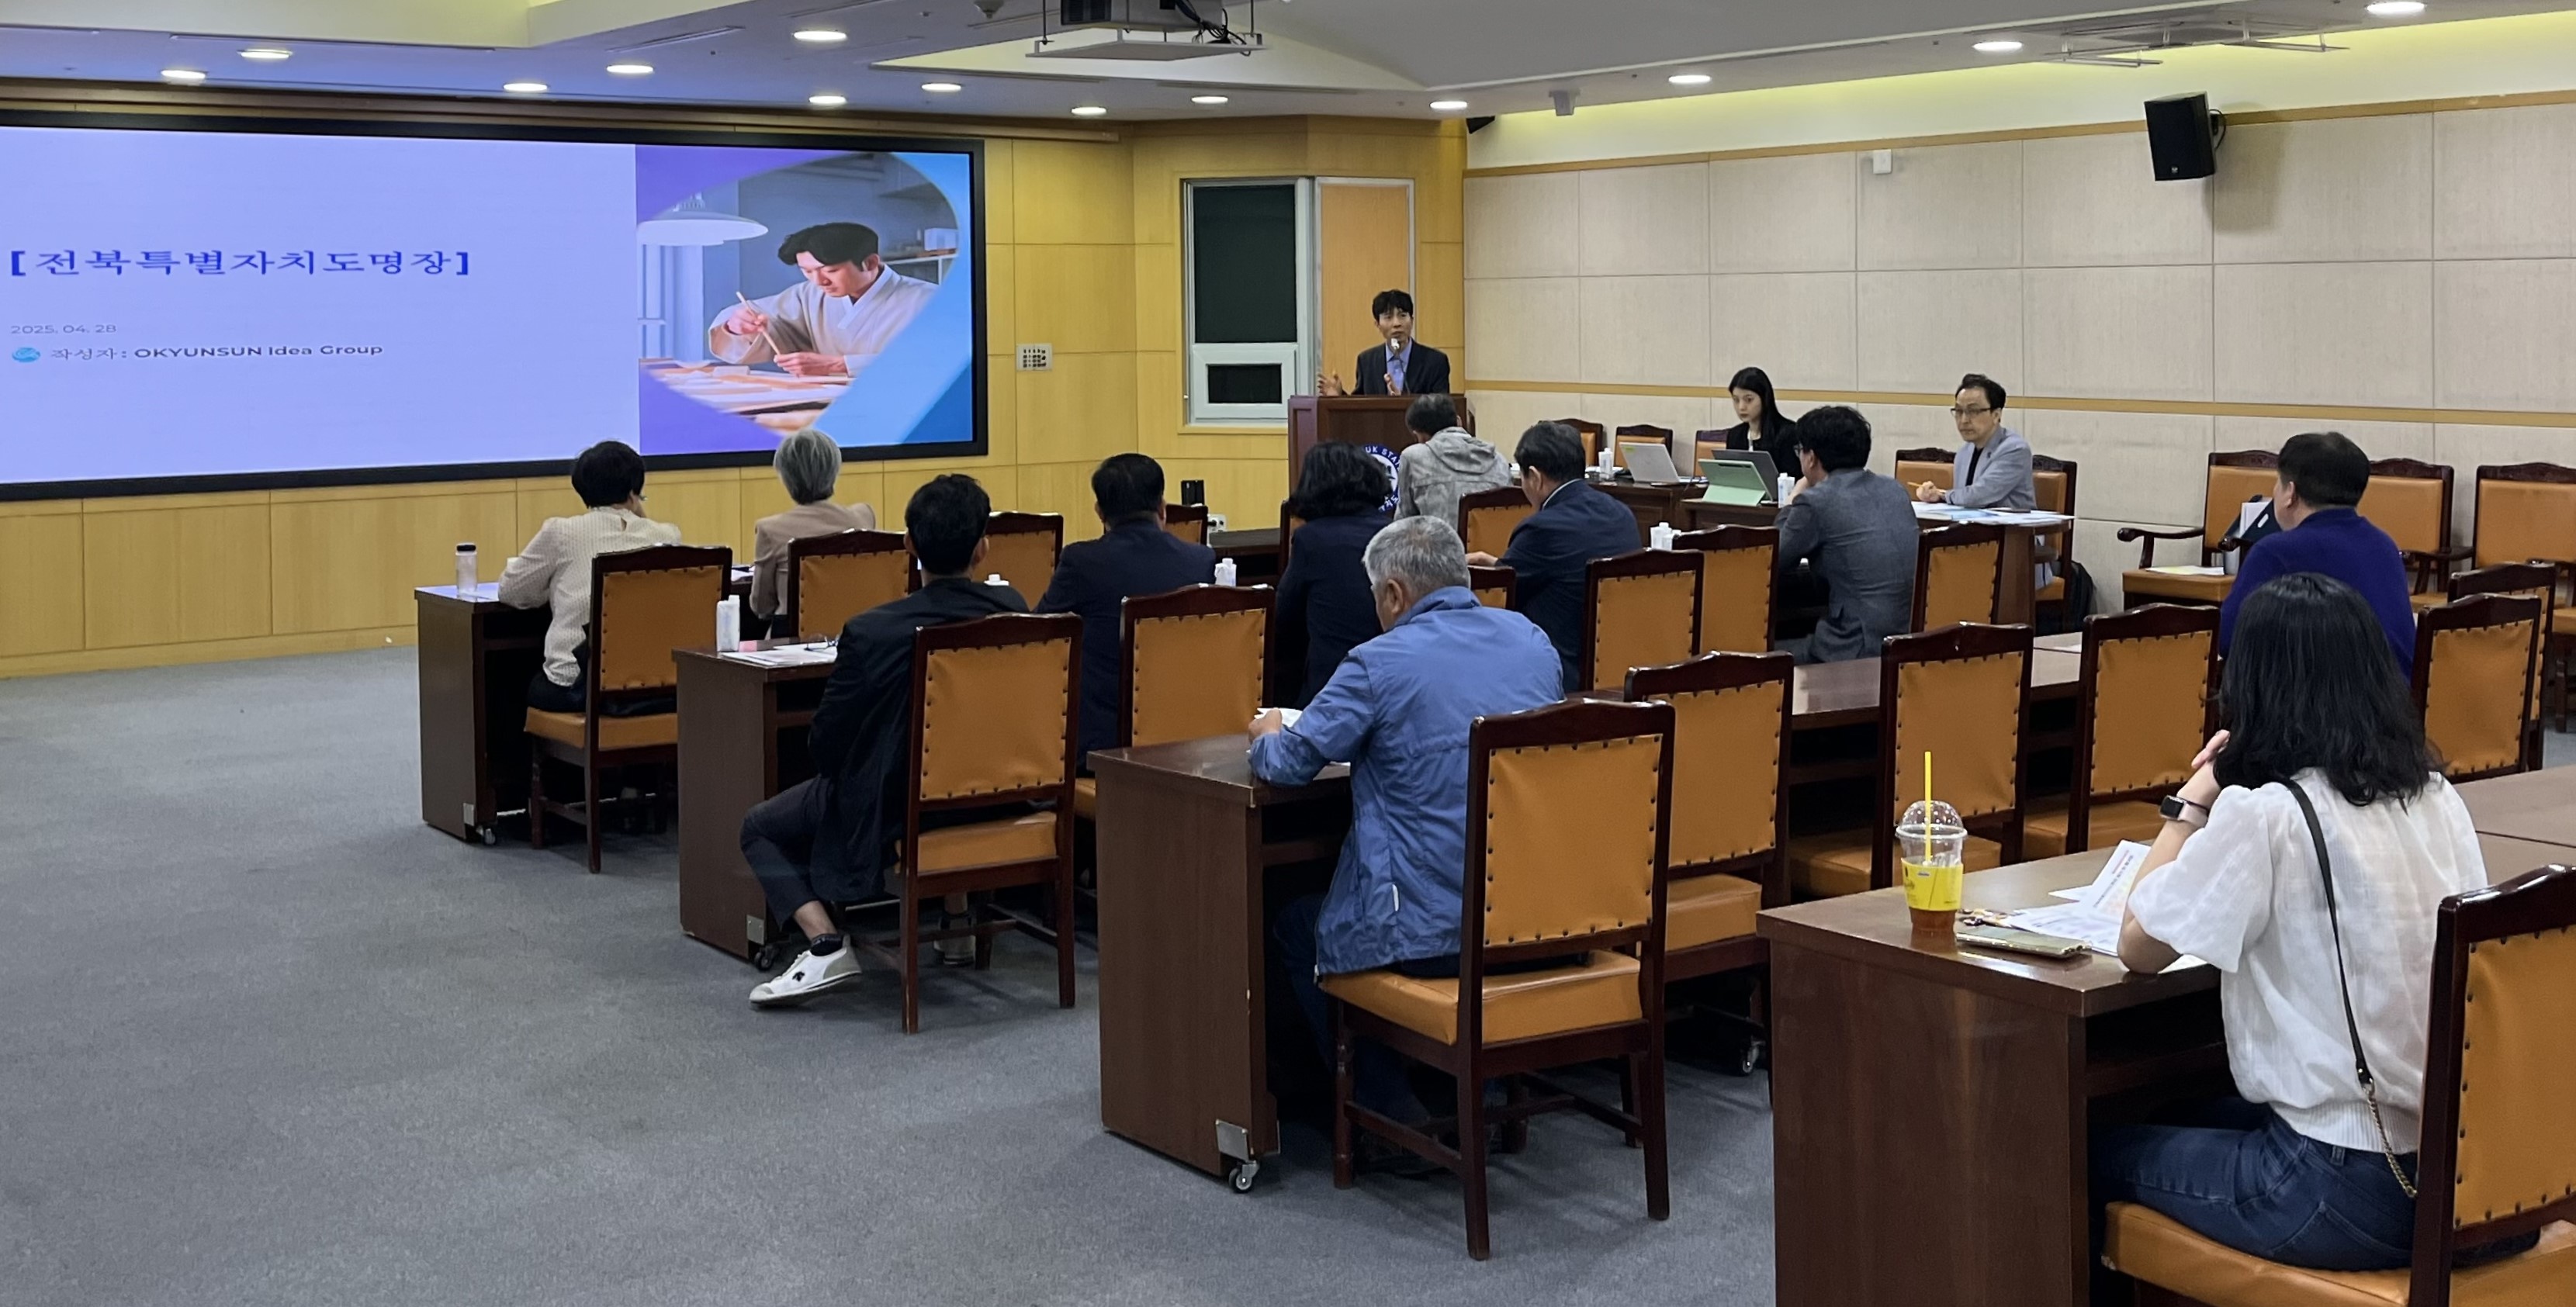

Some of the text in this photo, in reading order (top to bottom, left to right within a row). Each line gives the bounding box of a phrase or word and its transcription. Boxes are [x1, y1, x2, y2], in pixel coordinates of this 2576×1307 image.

[10, 323, 118, 335] 2025. 04. 28
[133, 346, 262, 358] OKYUNSUN
[268, 345, 313, 356] Idea
[319, 344, 384, 356] Group
